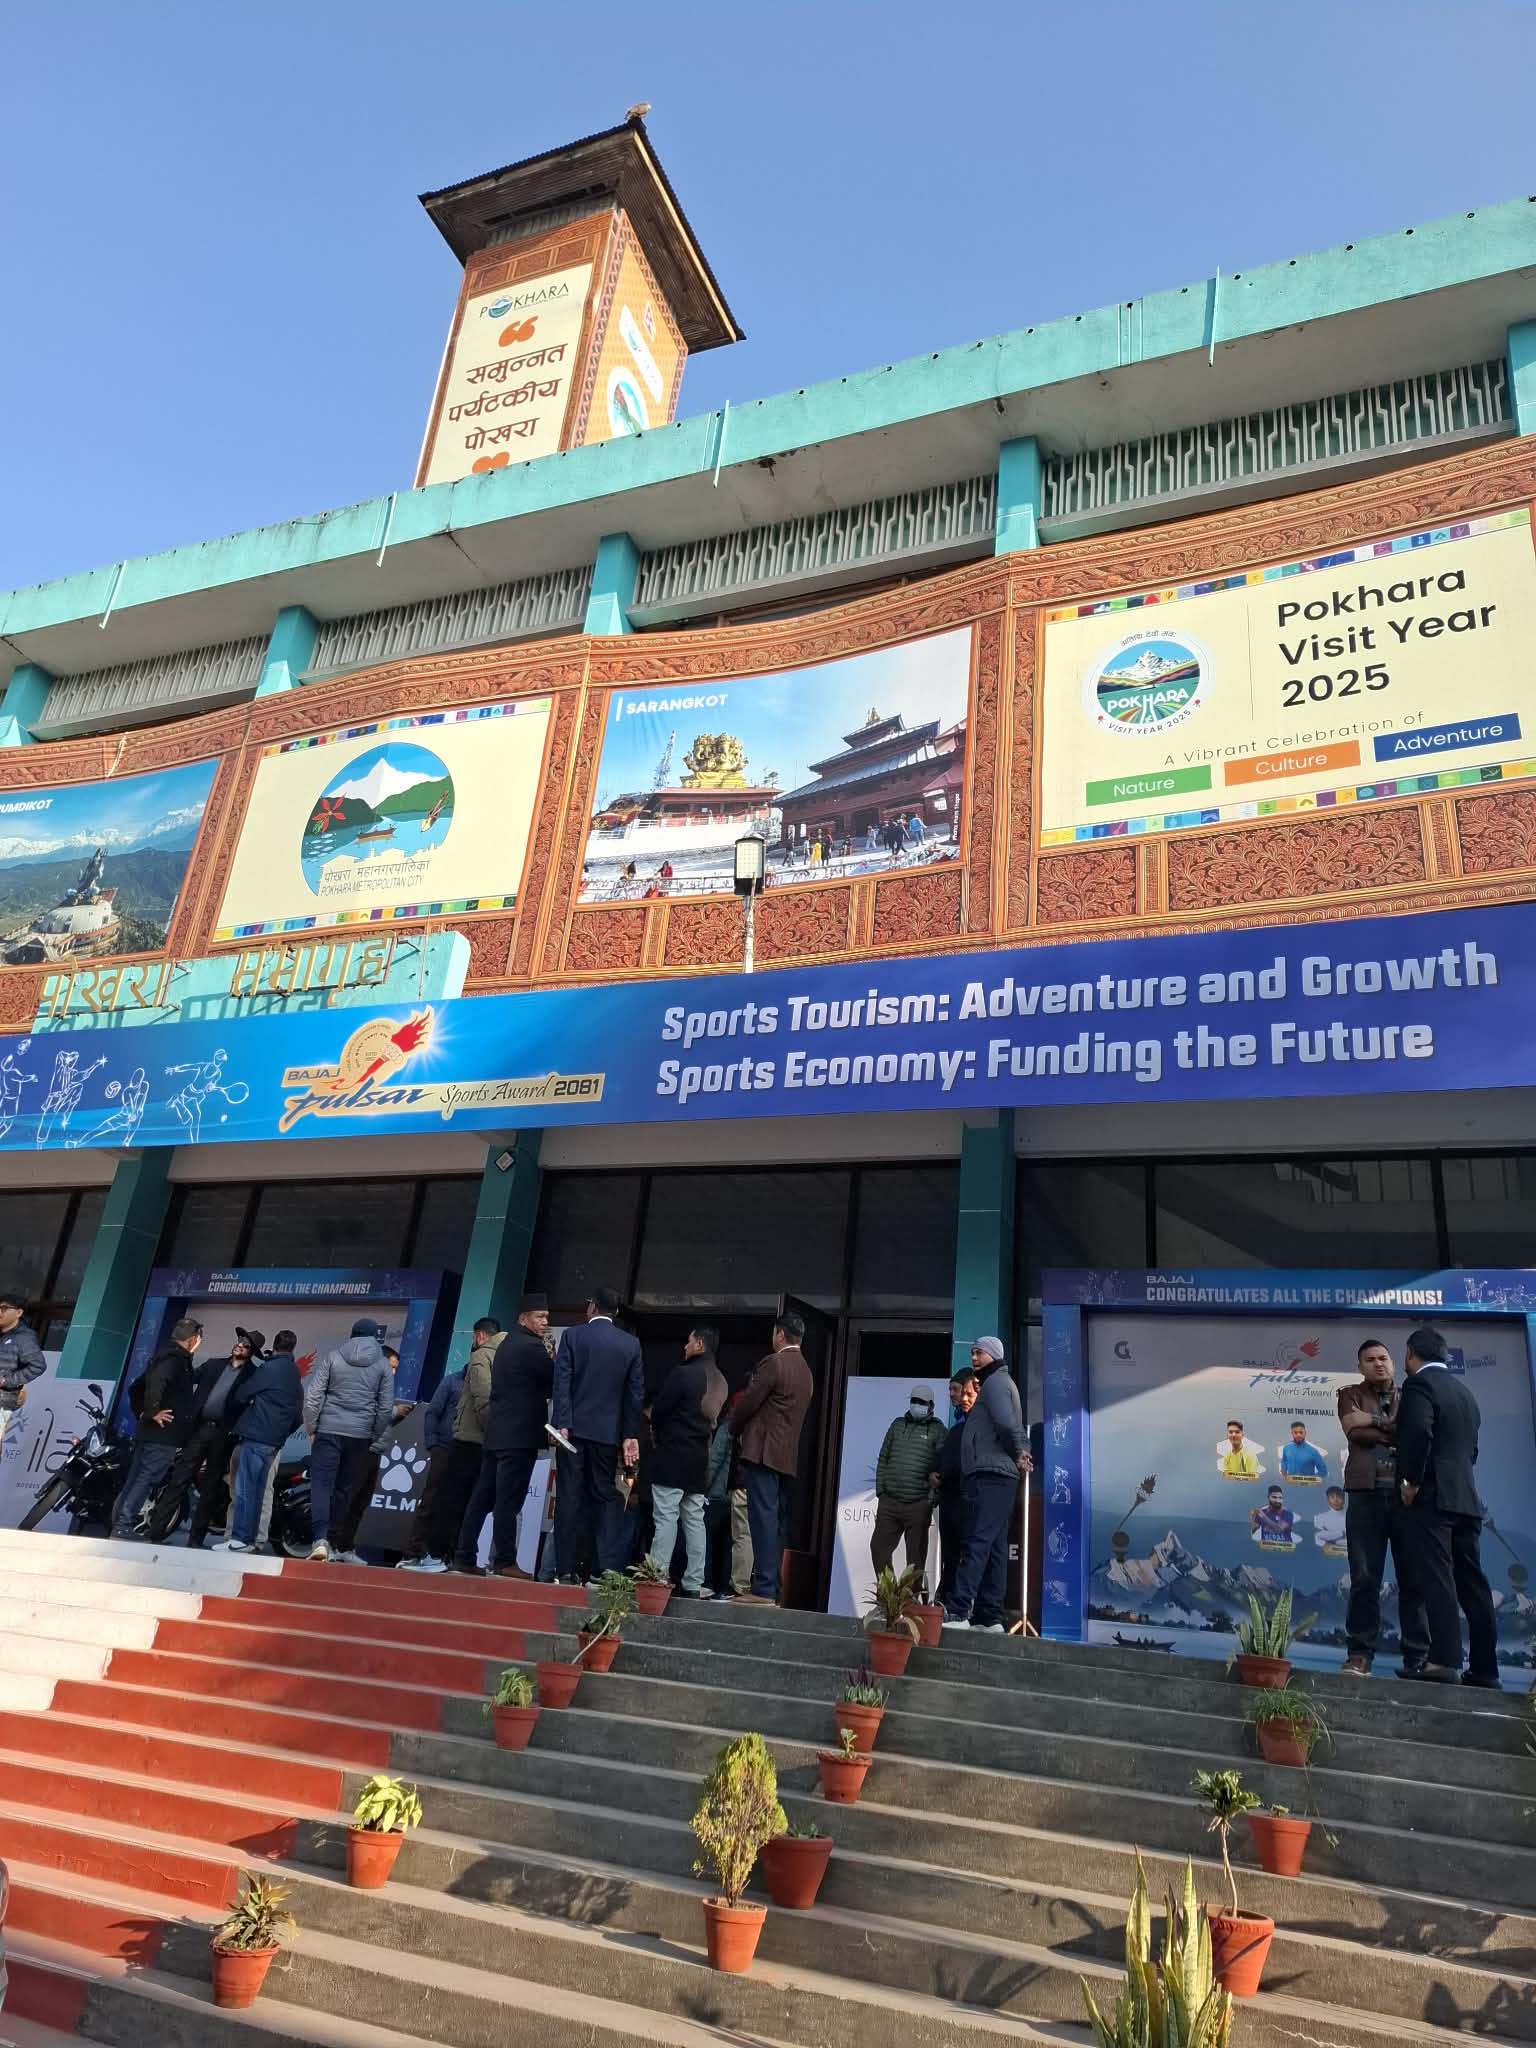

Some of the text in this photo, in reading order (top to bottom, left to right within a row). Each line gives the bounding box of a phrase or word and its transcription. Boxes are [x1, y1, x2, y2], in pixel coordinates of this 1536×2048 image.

[466, 343, 568, 385] समुन्नत
[449, 378, 562, 422] पर्यटकीय
[465, 417, 540, 450] पोखरा
[1277, 568, 1466, 628] Pokhara
[1279, 603, 1498, 666] Visit Year
[1282, 663, 1391, 708] 2025
[625, 693, 729, 716] SARANGKOT
[1107, 688, 1190, 713] POKHARA
[1108, 710, 1192, 735] VISIT YEAR 2025
[1164, 711, 1425, 767] A Vibrant Celebration of
[1393, 721, 1504, 754] Adventure
[1255, 751, 1329, 777] Culture
[1113, 775, 1176, 799] Nature
[0, 799, 54, 813] UMDIKOT
[320, 875, 425, 897] POKHARA METROPOLITAN CITY
[39, 955, 176, 1018] पोखरा
[661, 941, 1498, 1049] Sports Tourism: Adventure and Growth
[287, 1067, 341, 1081] BAJAJ
[656, 1021, 1434, 1104] Sports Economy: Funding the Future
[439, 1075, 600, 1112] Sports Award 2081
[208, 1281, 371, 1295] CONGRATULATES ALL THE CHAMPIONS!
[210, 1272, 240, 1280] BAJAJ
[1146, 1275, 1194, 1285] BAJAJ
[1146, 1287, 1443, 1306] CONGRATULATES ALL THE CHAMPIONS!
[1272, 1385, 1335, 1400] Sports Award
